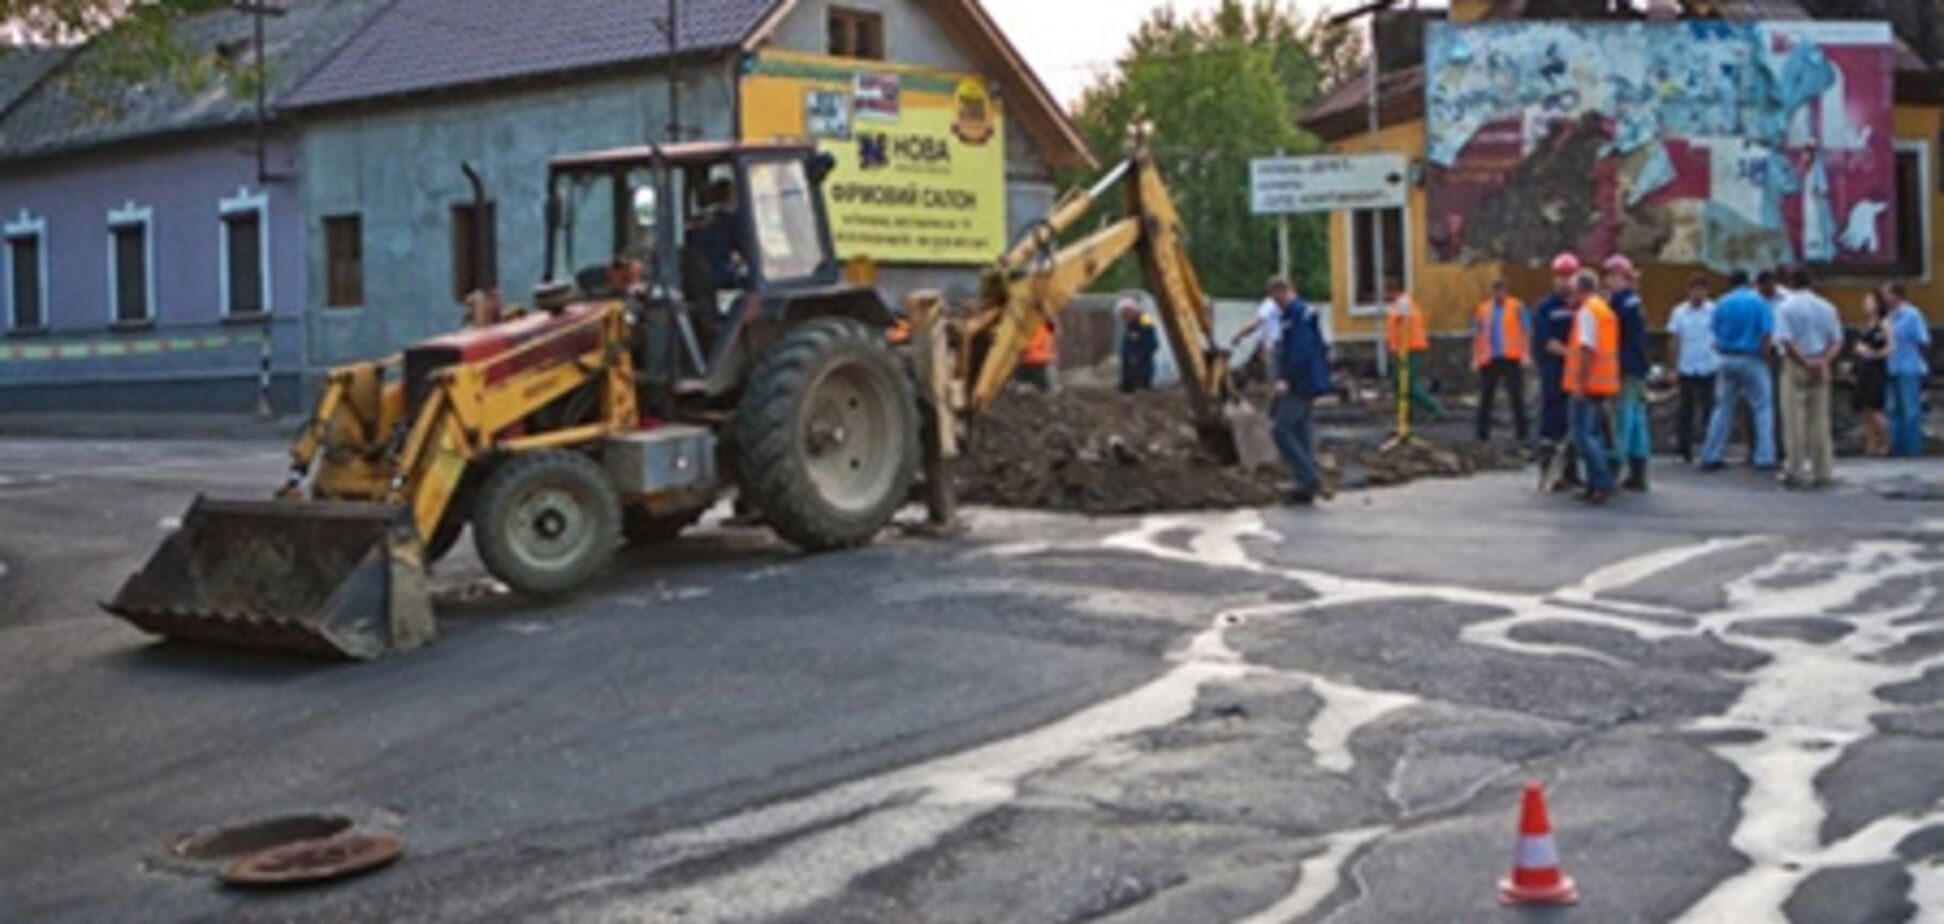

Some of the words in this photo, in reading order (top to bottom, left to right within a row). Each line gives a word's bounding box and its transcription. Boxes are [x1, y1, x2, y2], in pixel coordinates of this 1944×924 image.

[894, 135, 950, 161] НОВА
[832, 182, 917, 206] ФІРМОВИЙ
[923, 188, 977, 210] САЛОН
